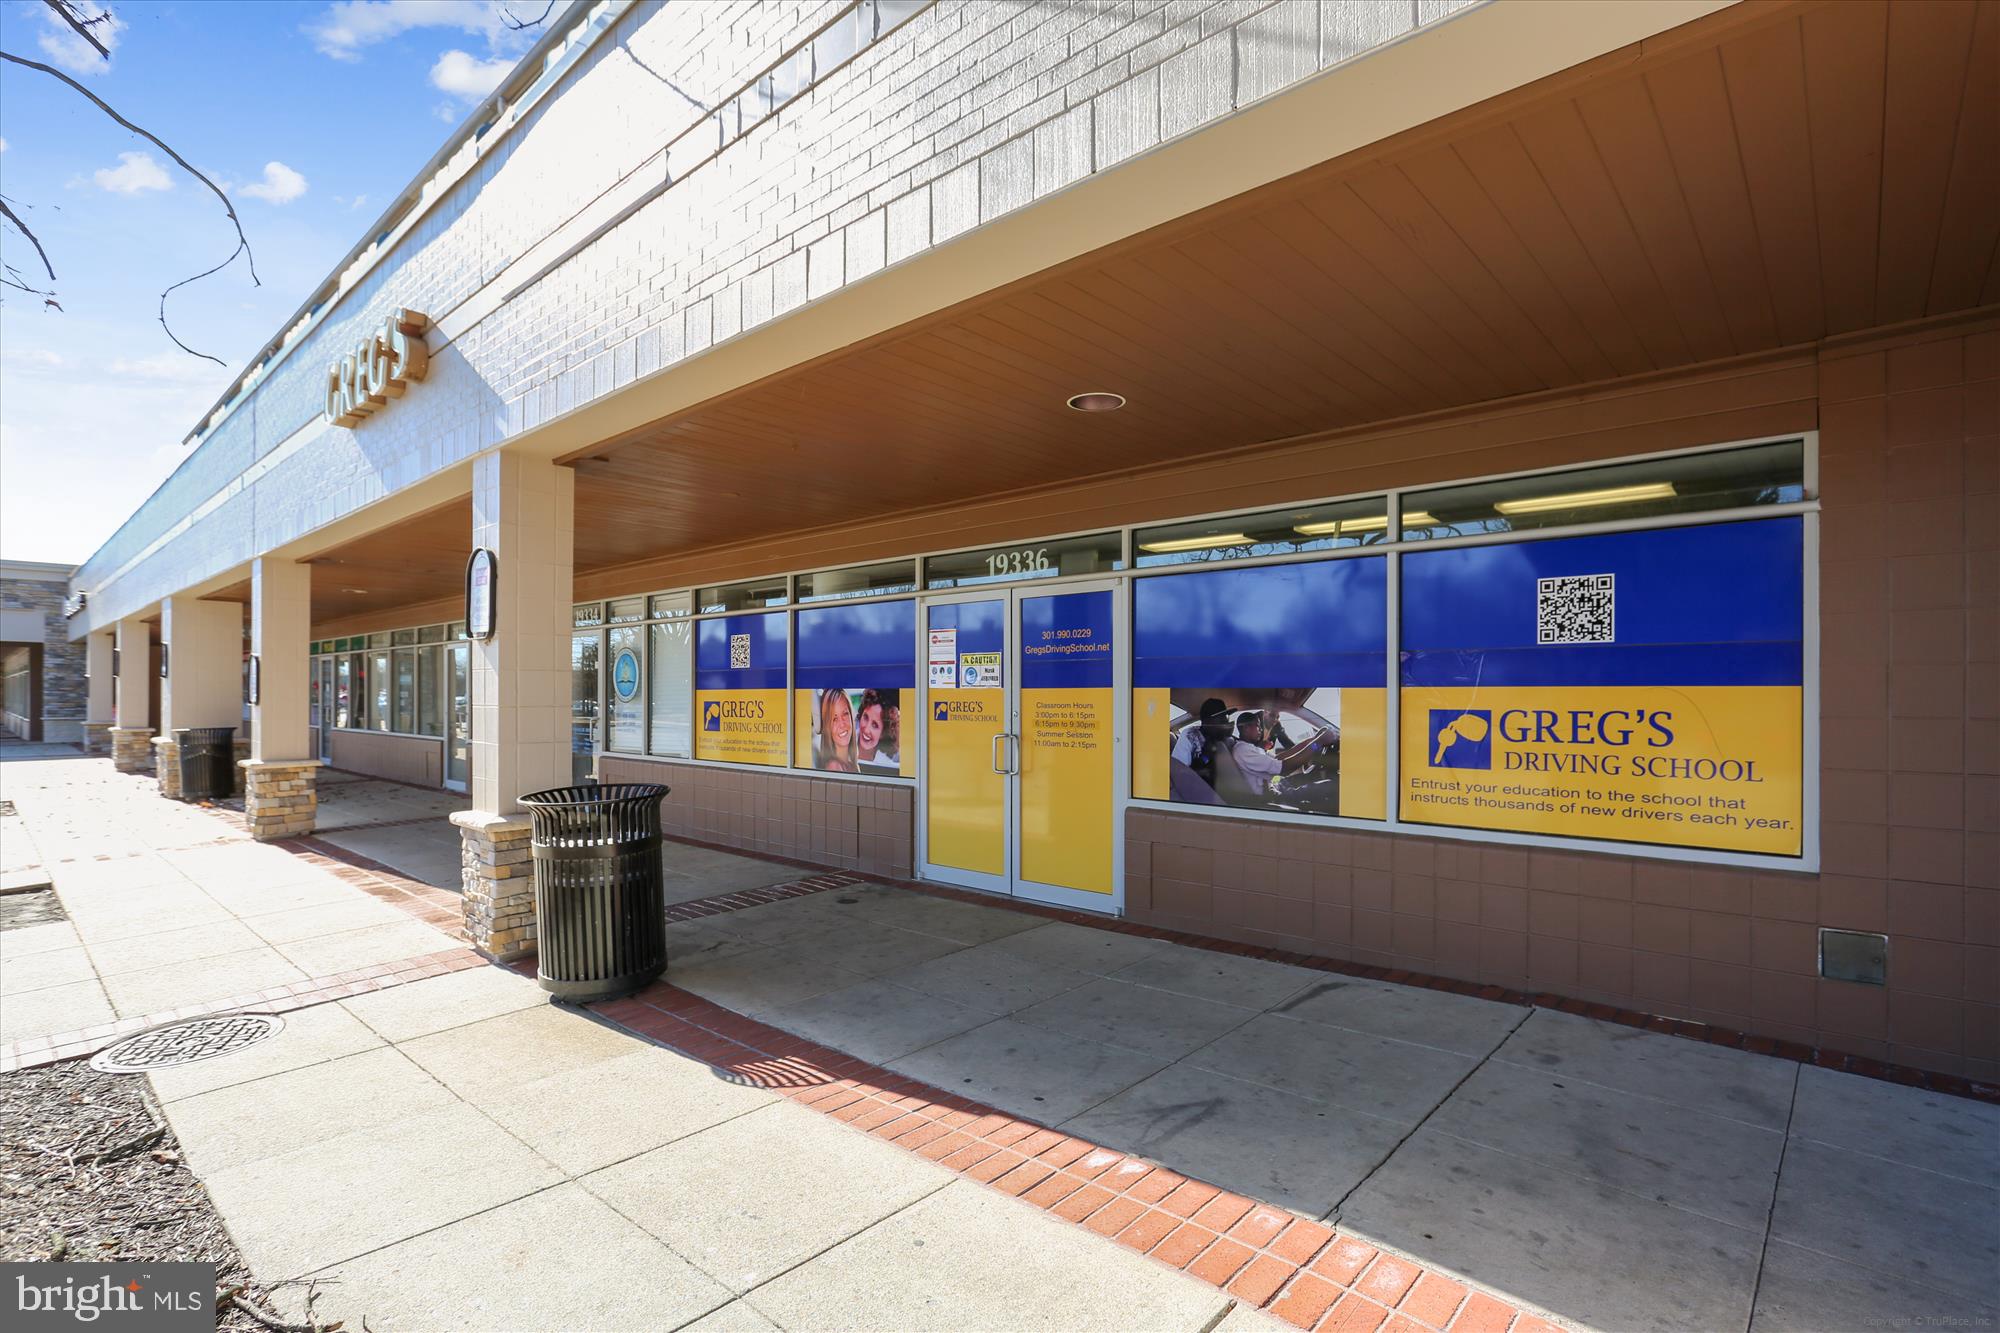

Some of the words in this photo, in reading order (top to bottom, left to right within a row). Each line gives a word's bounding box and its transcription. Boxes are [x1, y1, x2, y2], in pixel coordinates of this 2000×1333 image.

[325, 305, 425, 426] GREG'S
[985, 548, 1049, 577] 19336
[576, 607, 599, 621] 19334
[1042, 628, 1092, 640] 301.990.0229
[1025, 643, 1110, 655] GregsDrivingSchool.net
[722, 700, 764, 719] GREG'S
[949, 701, 983, 712] GREG'S
[723, 721, 752, 733] DRIVING
[753, 722, 784, 734] SCHOOL
[1037, 730, 1064, 738] Summer
[1066, 730, 1093, 739] Session
[1500, 708, 1675, 748] GREG'S
[1062, 740, 1069, 748] to
[1504, 750, 1621, 776] DRIVING
[1631, 755, 1764, 783] SCHOOL
[1411, 778, 1461, 791] Entrust
[1465, 783, 1498, 795] your
[1502, 784, 1580, 799] education
[1587, 789, 1602, 800] to
[1608, 790, 1635, 803] the
[1641, 793, 1702, 807] school
[1709, 796, 1746, 810] that
[1411, 791, 1469, 806] instructs
[1474, 796, 1554, 812] thousands
[1559, 803, 1576, 814] of
[1581, 806, 1616, 816] new
[1621, 807, 1684, 822] drivers
[1690, 813, 1737, 826] each
[1744, 817, 1795, 830] year.
